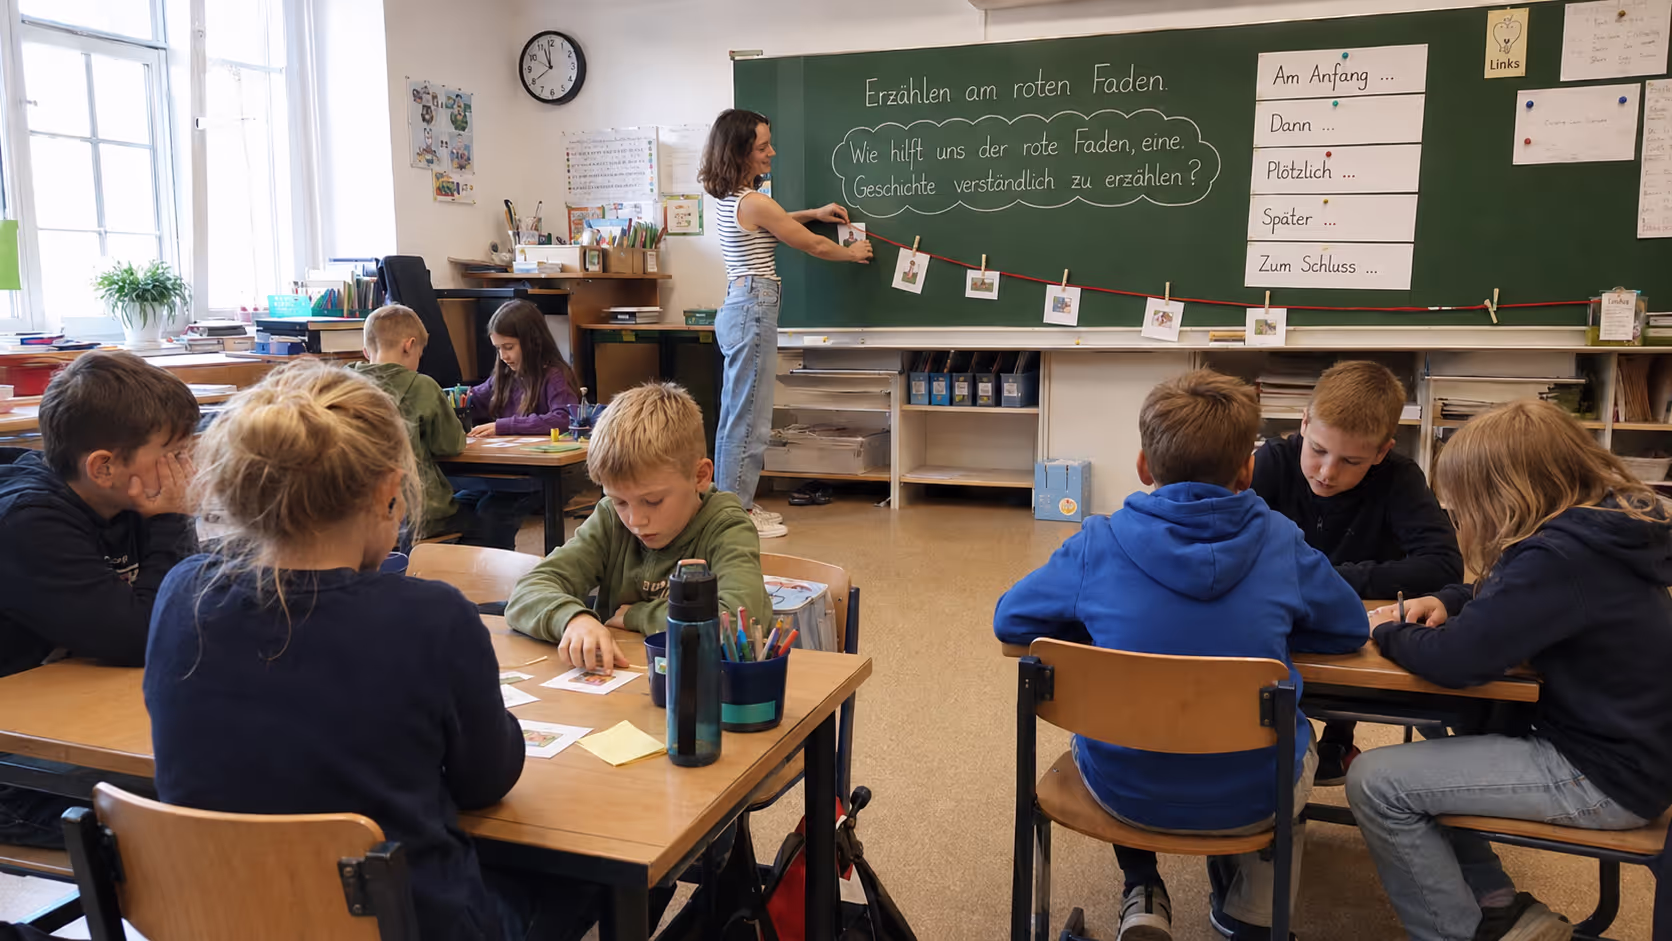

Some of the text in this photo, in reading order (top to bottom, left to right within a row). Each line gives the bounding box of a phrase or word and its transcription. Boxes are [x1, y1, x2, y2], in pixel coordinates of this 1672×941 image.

[529, 54, 537, 62] 10
[1490, 58, 1520, 71] Links
[865, 63, 1168, 107] Erzählen am roten Faden.
[1273, 65, 1299, 85] Am
[1309, 62, 1368, 91] Anfang
[1271, 113, 1311, 133] Dann
[850, 127, 1185, 170] Wie hilft uns der rote Faden, eine.
[853, 158, 1202, 199] Geschichte verständlich zu erzählen ?
[1267, 160, 1332, 180] Plötzlich
[1262, 207, 1313, 234] Später
[1259, 255, 1291, 273] Zum
[1301, 254, 1356, 273] Schluss
